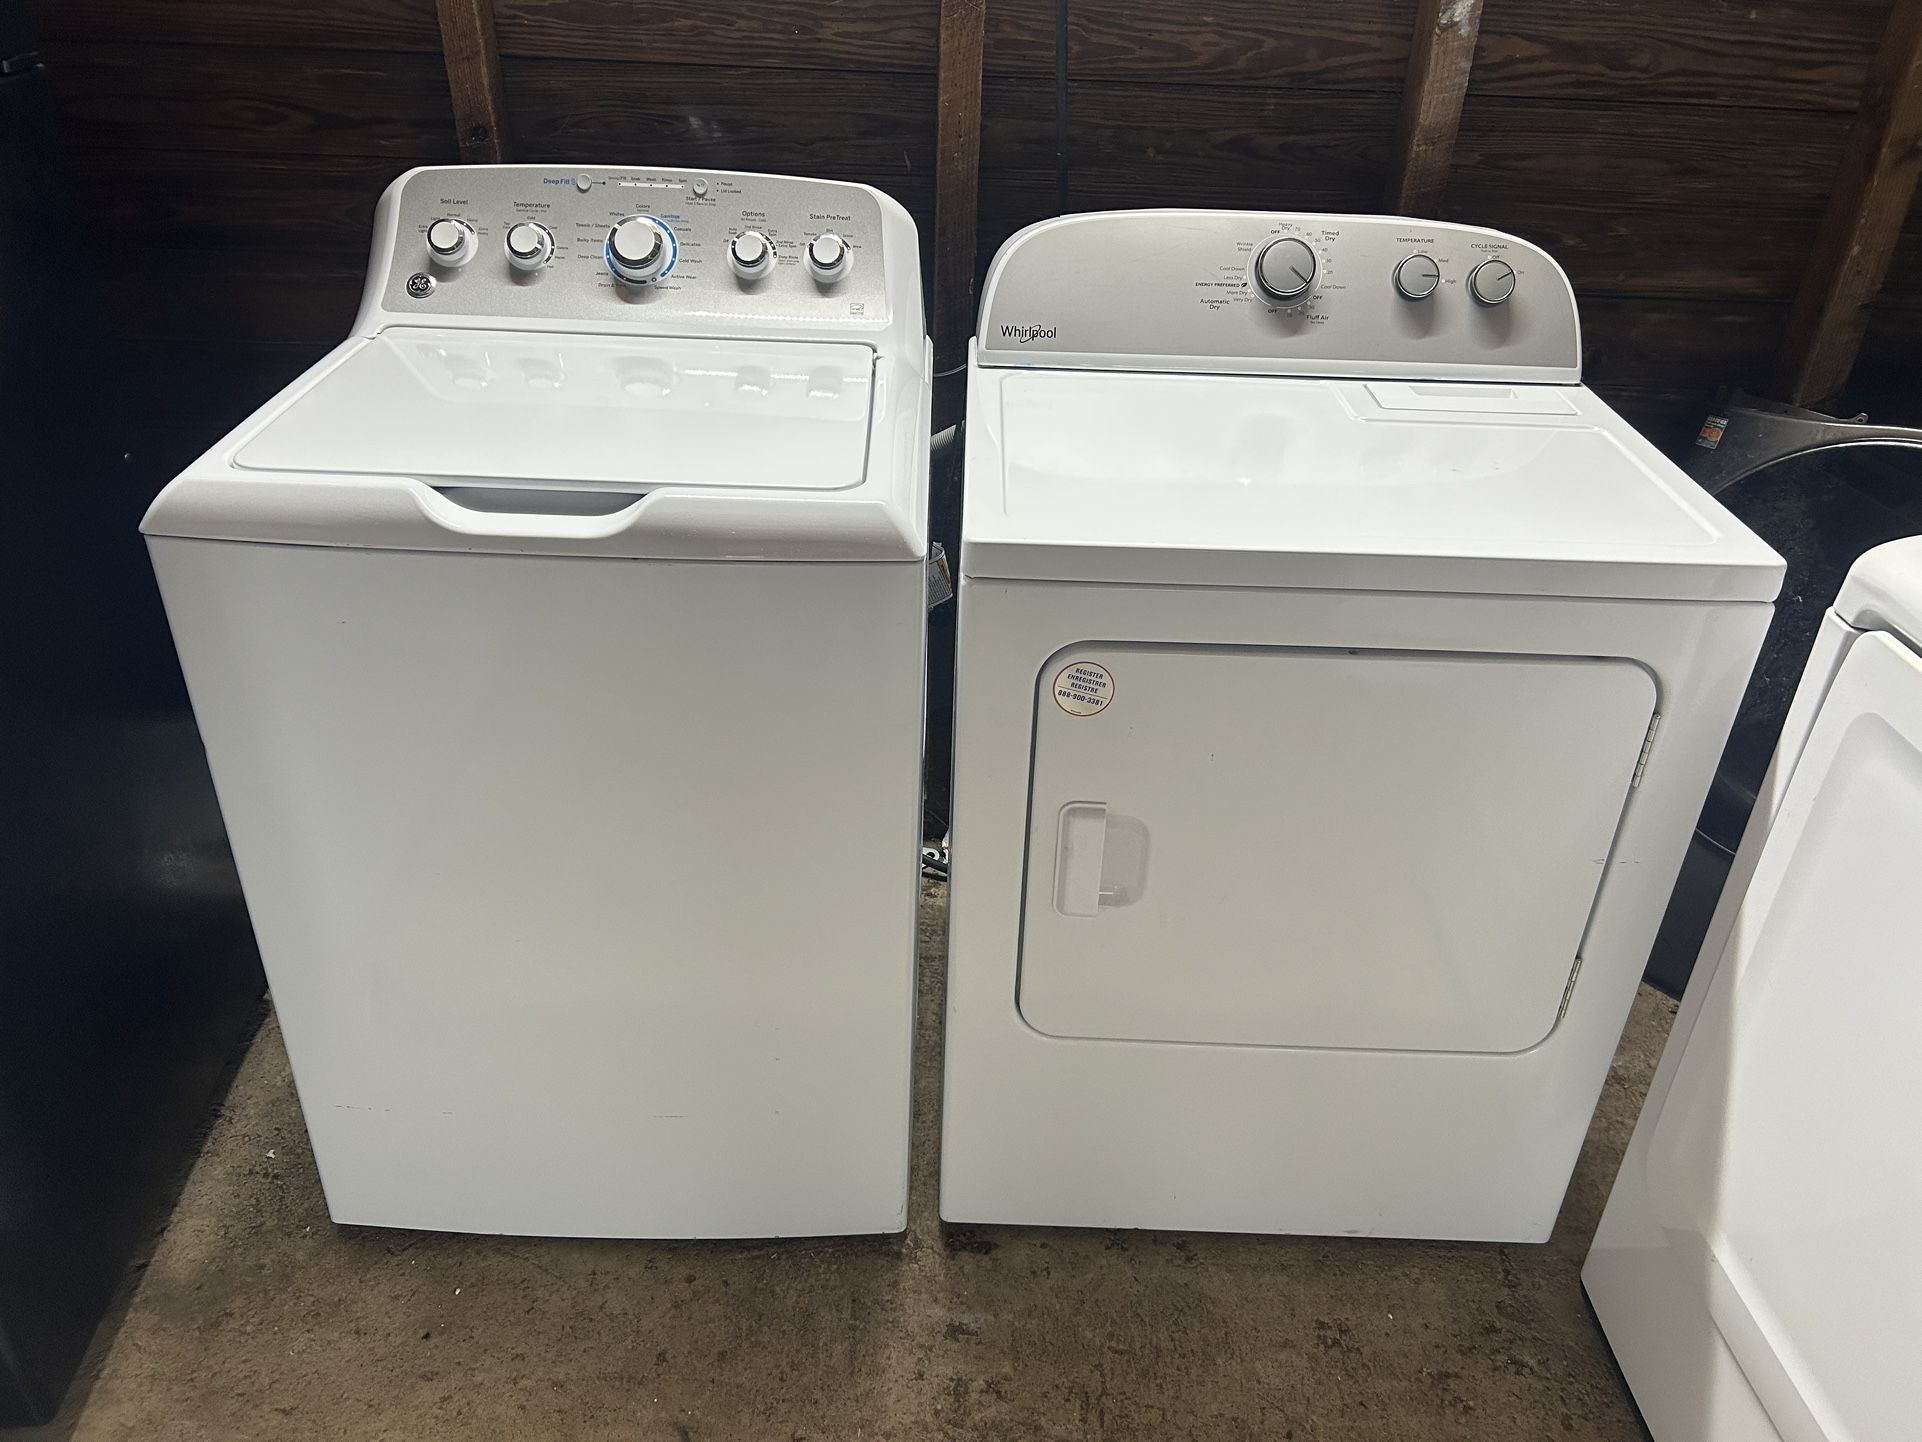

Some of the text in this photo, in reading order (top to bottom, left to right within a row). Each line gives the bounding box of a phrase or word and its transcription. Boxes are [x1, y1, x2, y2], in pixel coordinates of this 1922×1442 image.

[1000, 324, 1057, 343] Whirlpool
[1067, 673, 1107, 688] ENREGISTRER
[1075, 668, 1103, 680] REGISTER
[1070, 682, 1098, 694] REGISTRE
[1057, 689, 1103, 706] 888-900-3381
